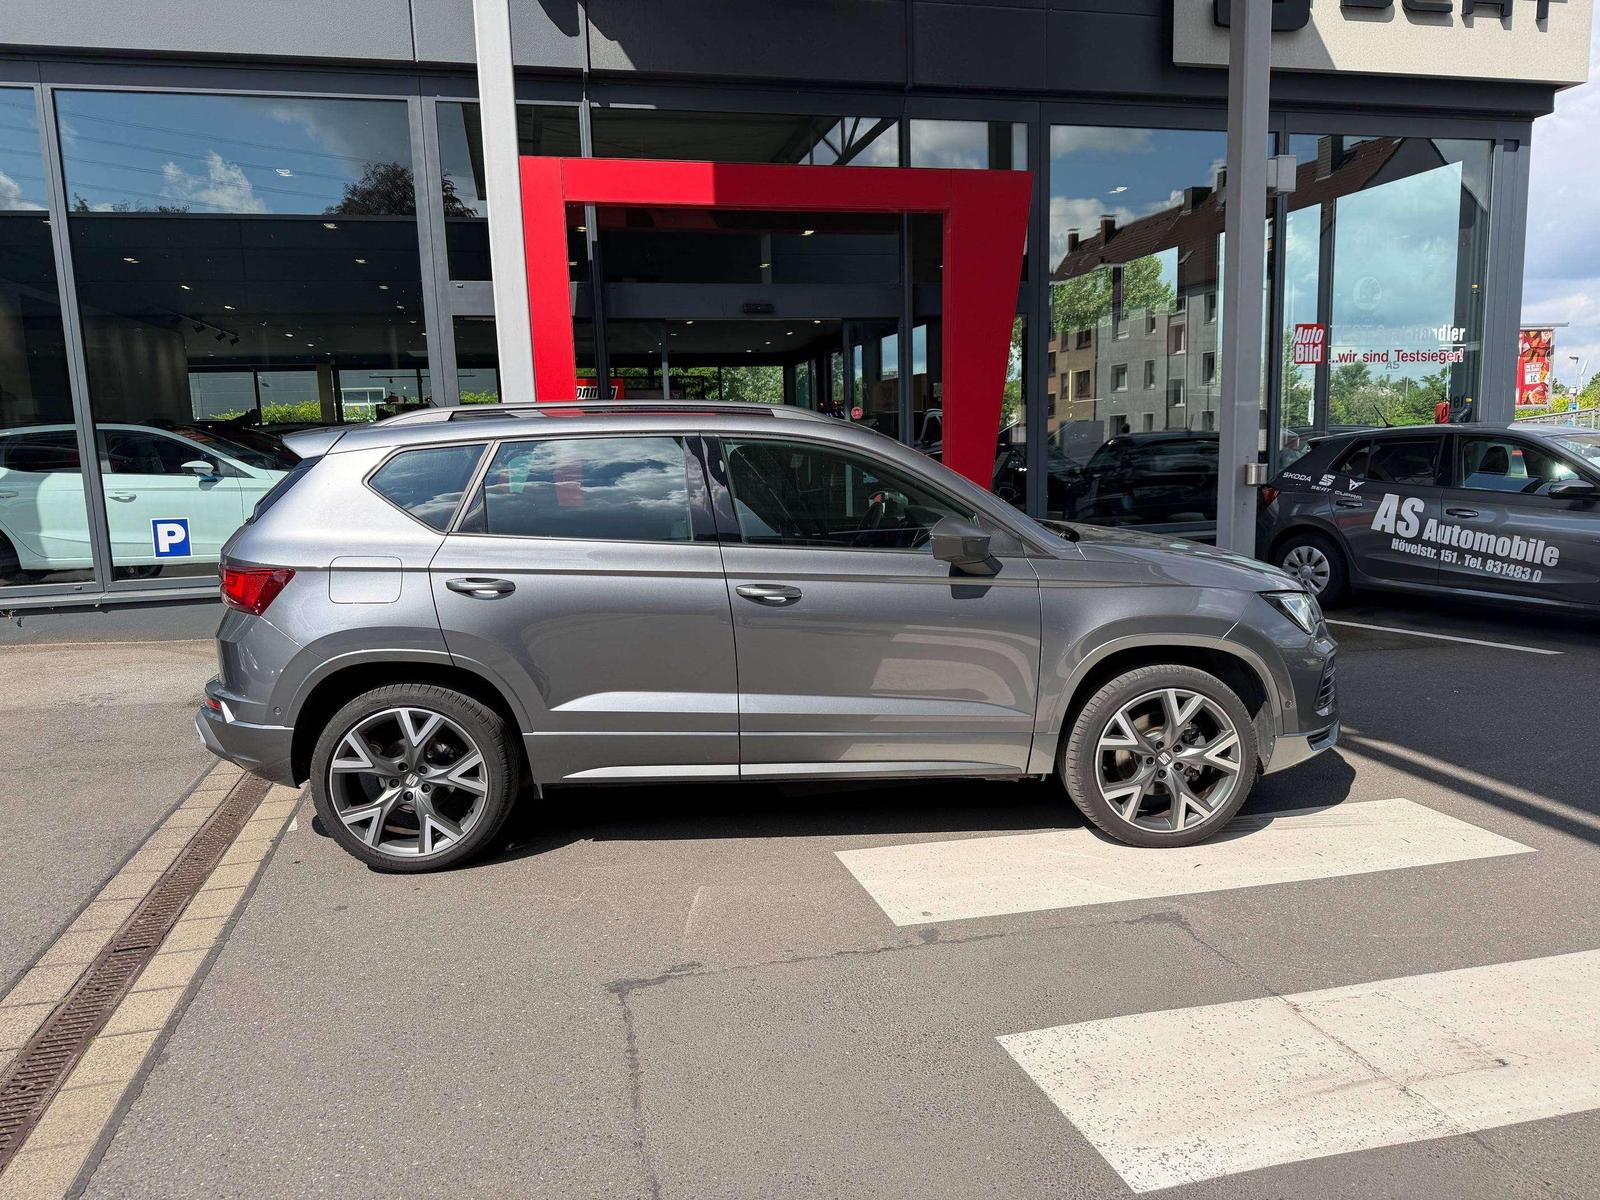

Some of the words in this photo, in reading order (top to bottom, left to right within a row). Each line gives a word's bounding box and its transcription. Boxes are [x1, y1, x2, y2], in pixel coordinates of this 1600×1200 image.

[1294, 326, 1324, 344] Auto
[1295, 344, 1322, 363] Bild
[1362, 348, 1389, 363] sind
[157, 524, 186, 553] P
[1371, 493, 1425, 539] AS
[1422, 518, 1560, 567] Automobile
[1391, 538, 1438, 560] Hövelstr.
[1464, 554, 1483, 570] Tel.
[1485, 559, 1532, 580] 831483
